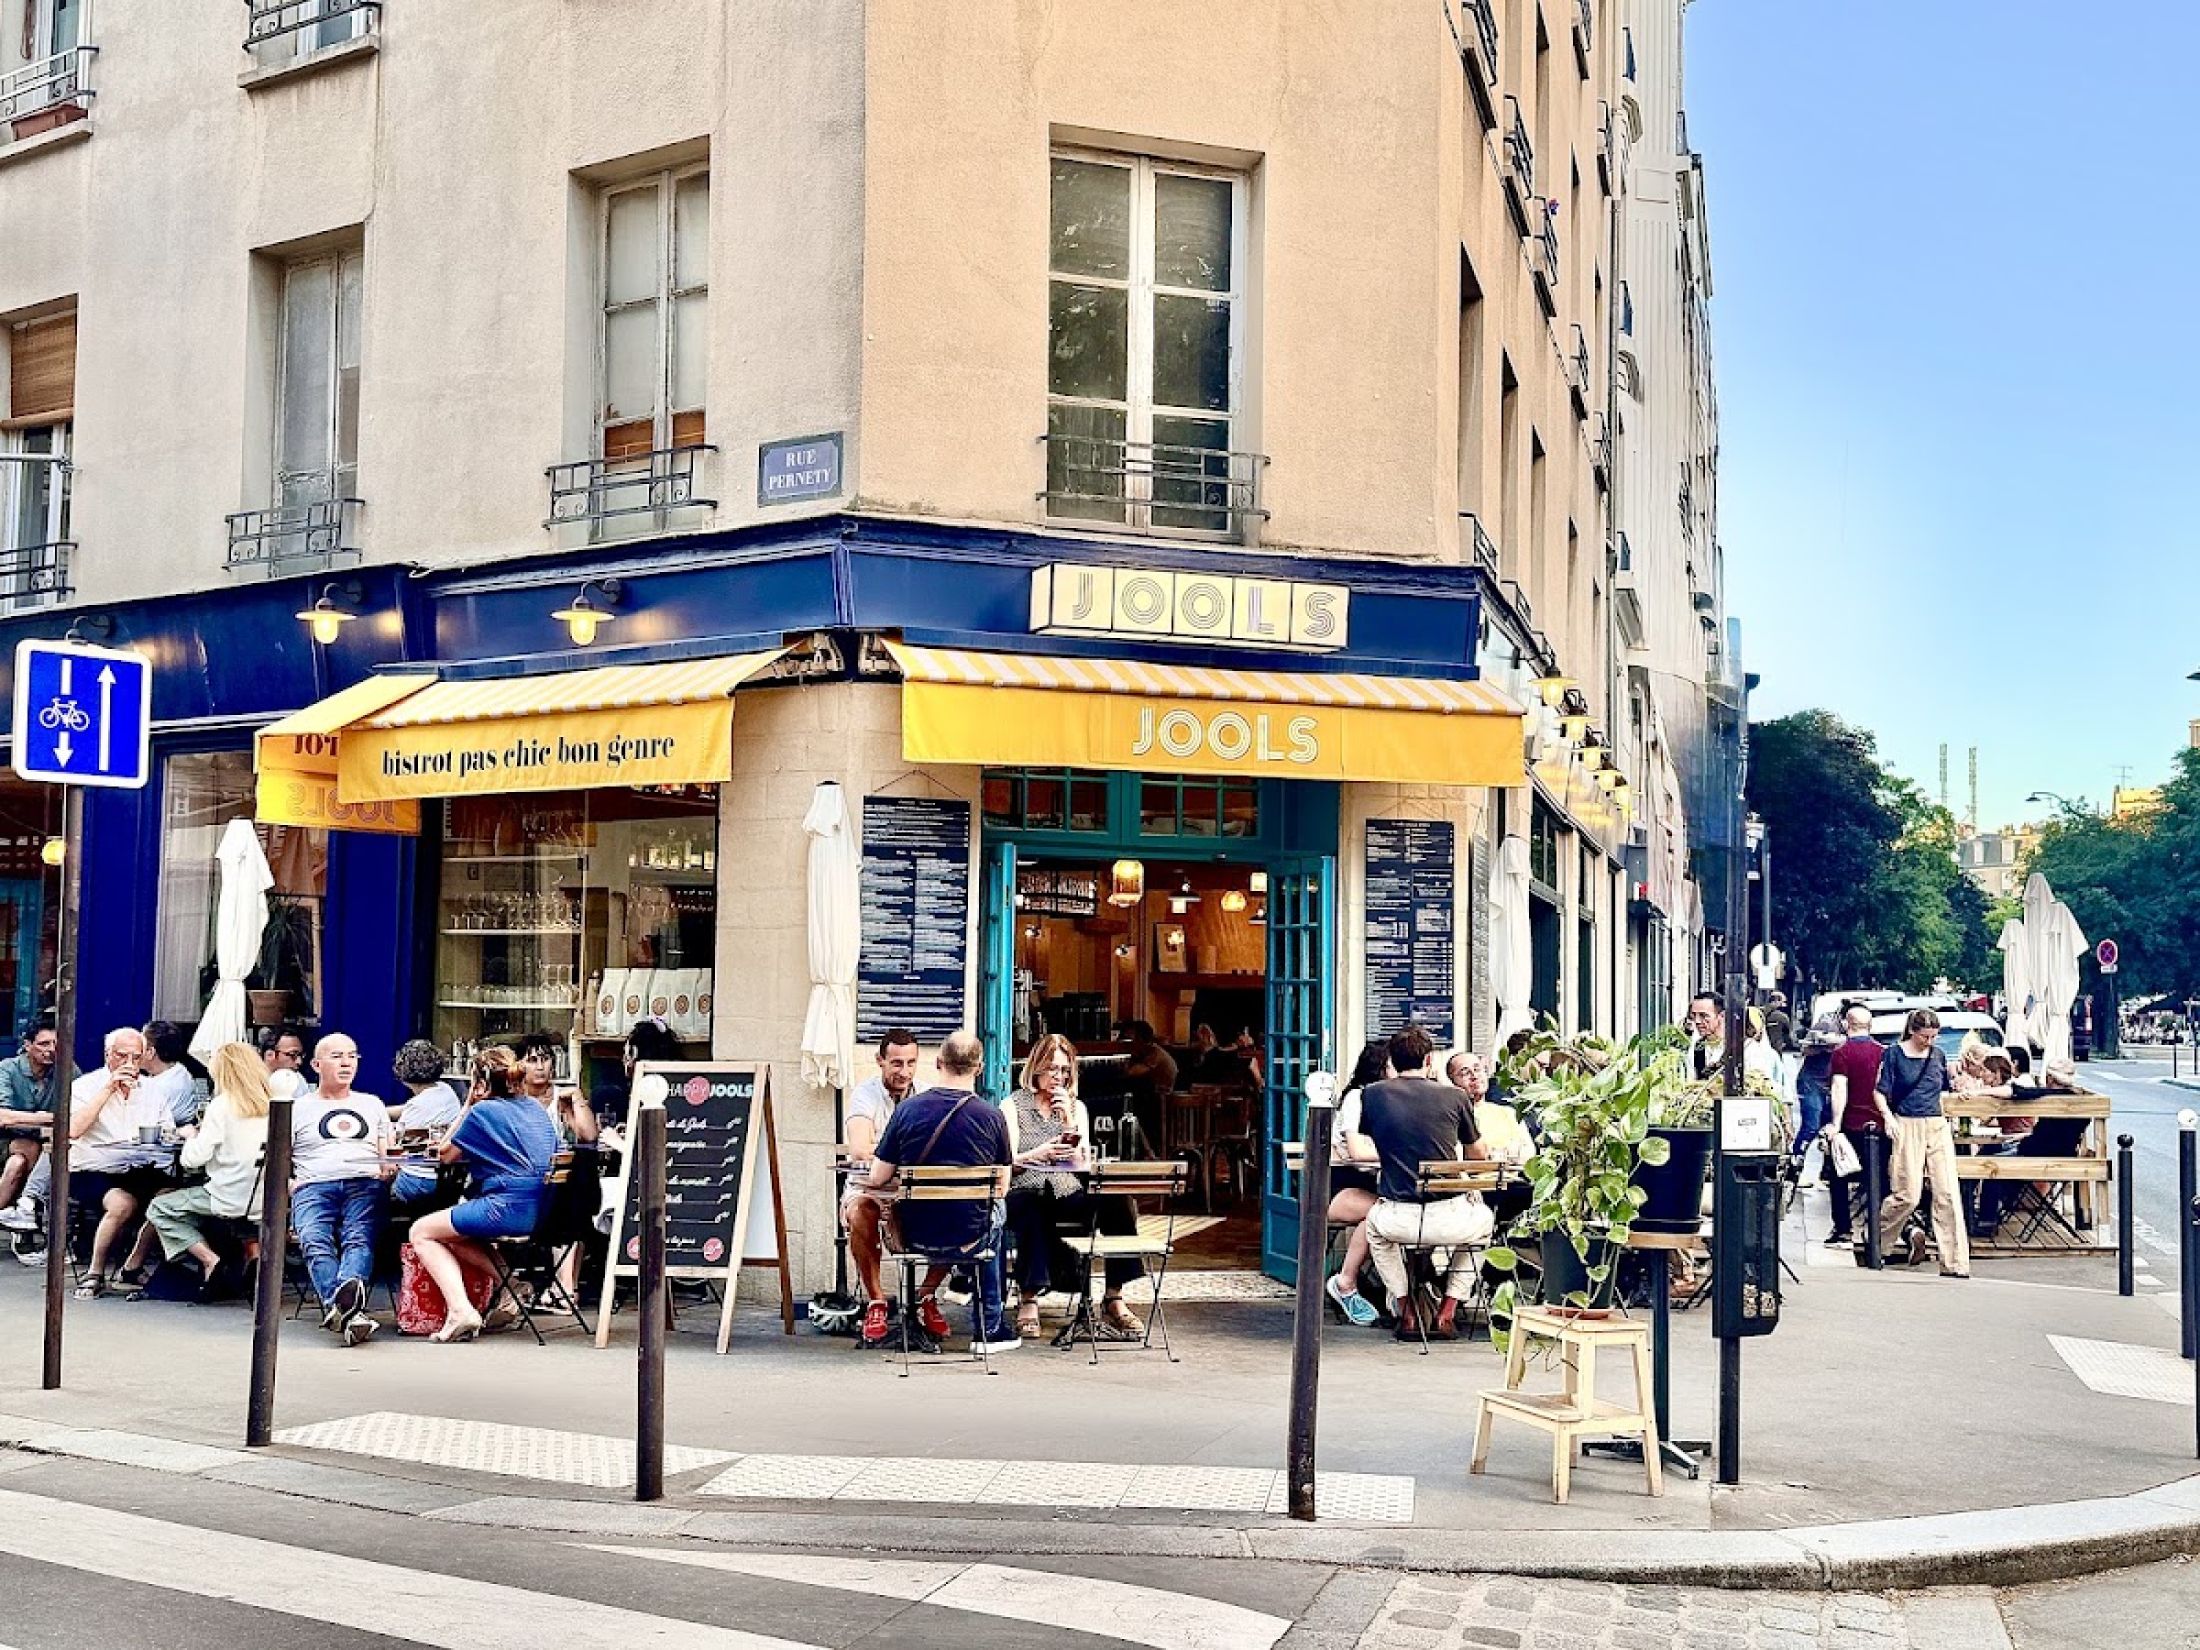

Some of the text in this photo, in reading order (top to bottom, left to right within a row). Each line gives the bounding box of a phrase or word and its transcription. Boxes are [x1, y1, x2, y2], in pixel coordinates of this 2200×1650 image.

[769, 468, 832, 490] PERNETY
[786, 448, 817, 468] RUE
[1071, 571, 1337, 639] JOOLS
[381, 734, 676, 777] bistrot pas chic bon genre
[1131, 706, 1320, 764] JOOLS
